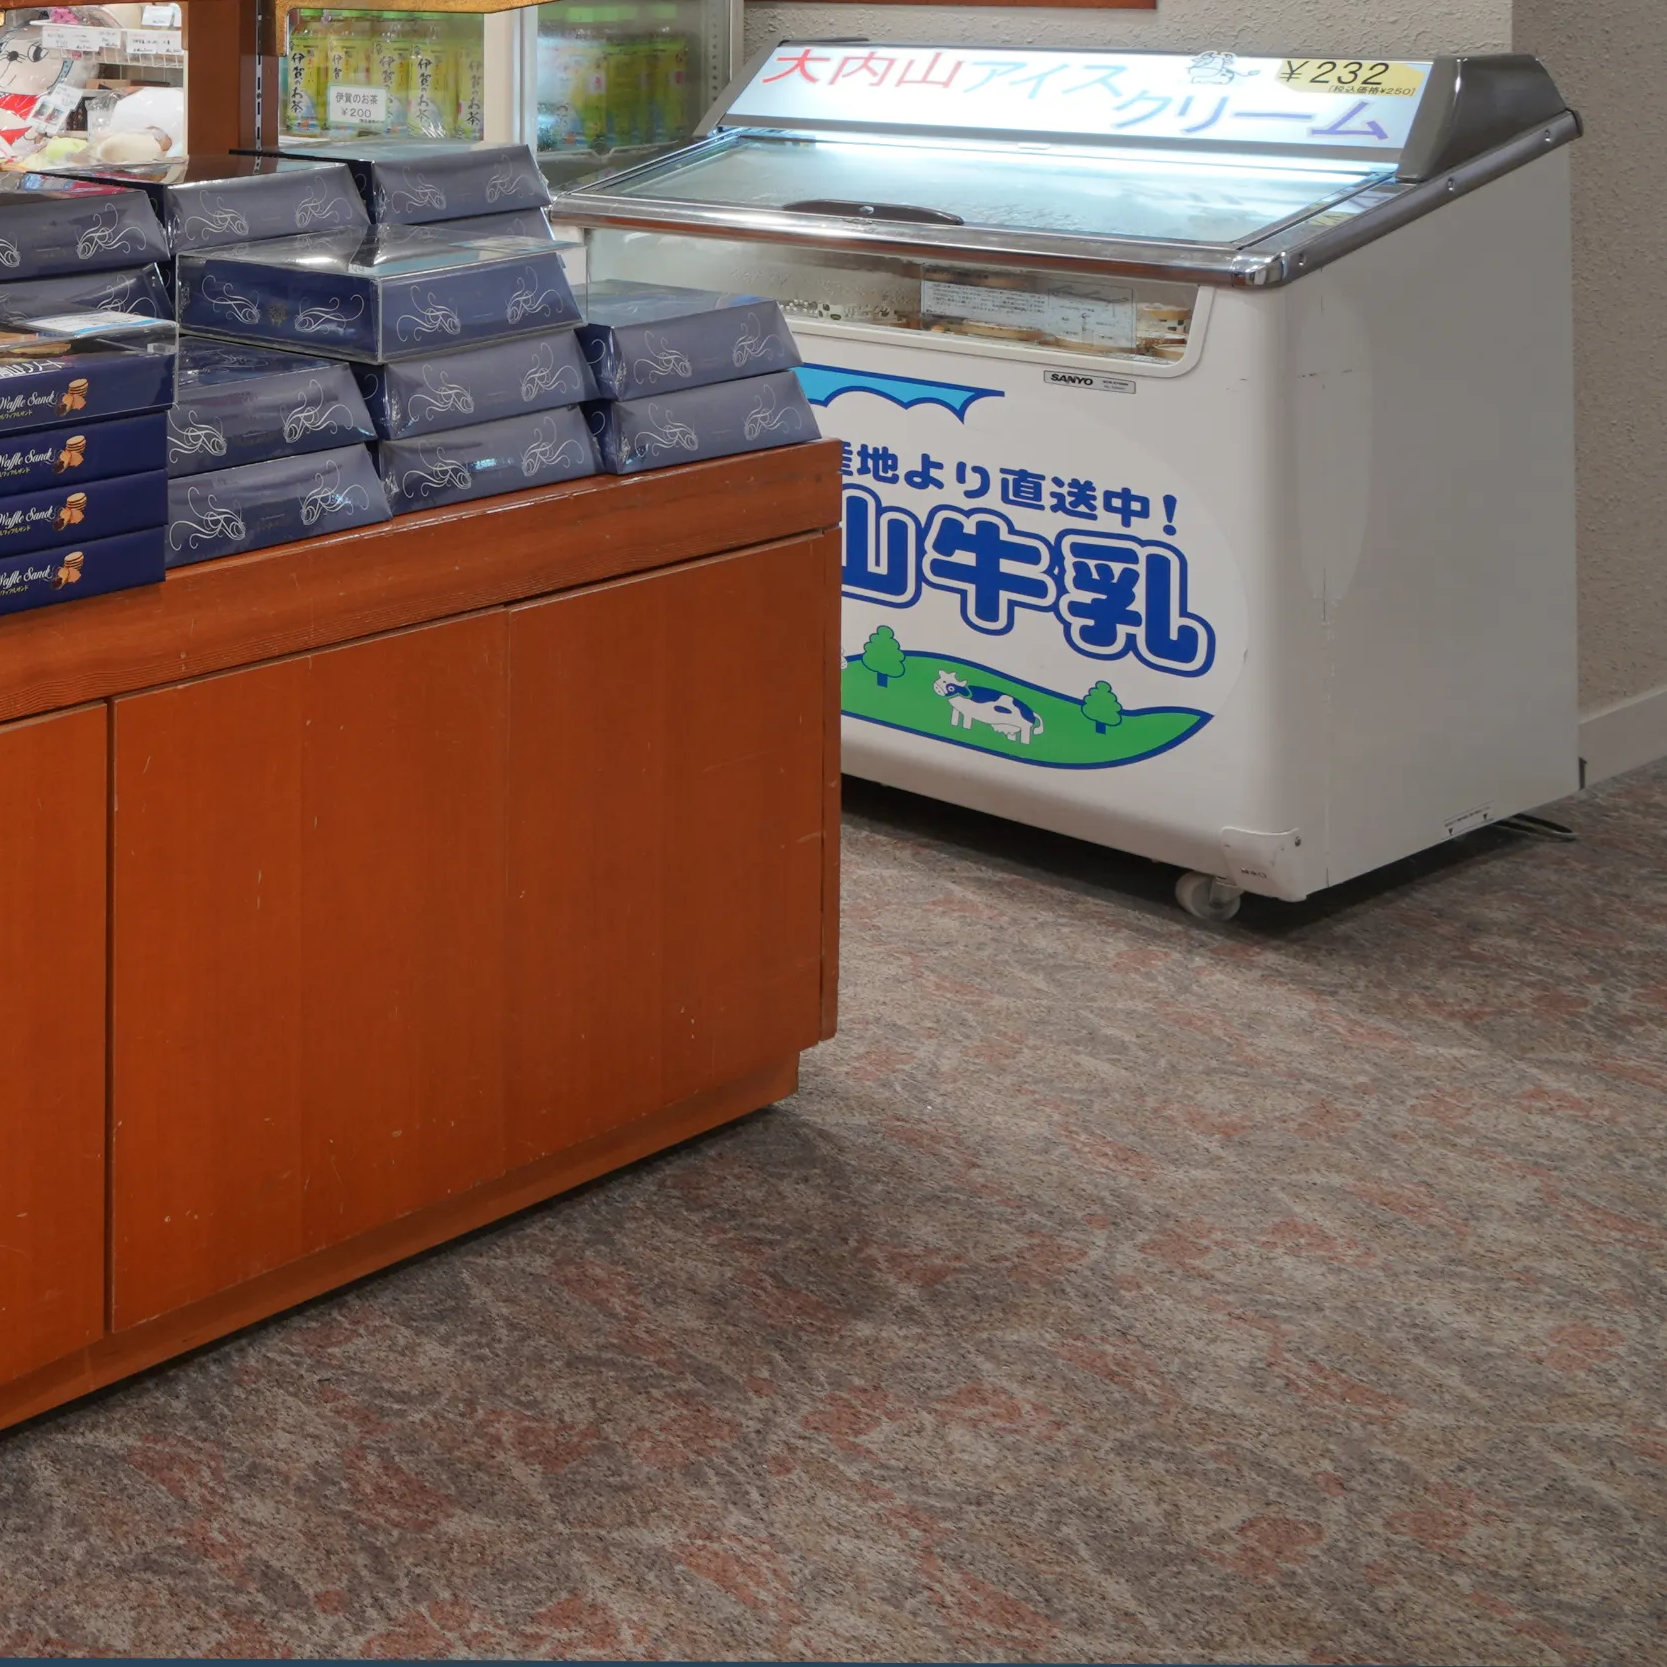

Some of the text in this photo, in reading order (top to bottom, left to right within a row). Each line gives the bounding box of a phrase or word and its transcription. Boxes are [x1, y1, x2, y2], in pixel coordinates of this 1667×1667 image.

[761, 48, 1128, 99] 大内山アイス
[336, 91, 379, 105] 伊賀のお茶
[1112, 89, 1390, 141] クリーム
[1050, 373, 1094, 386] SANYO
